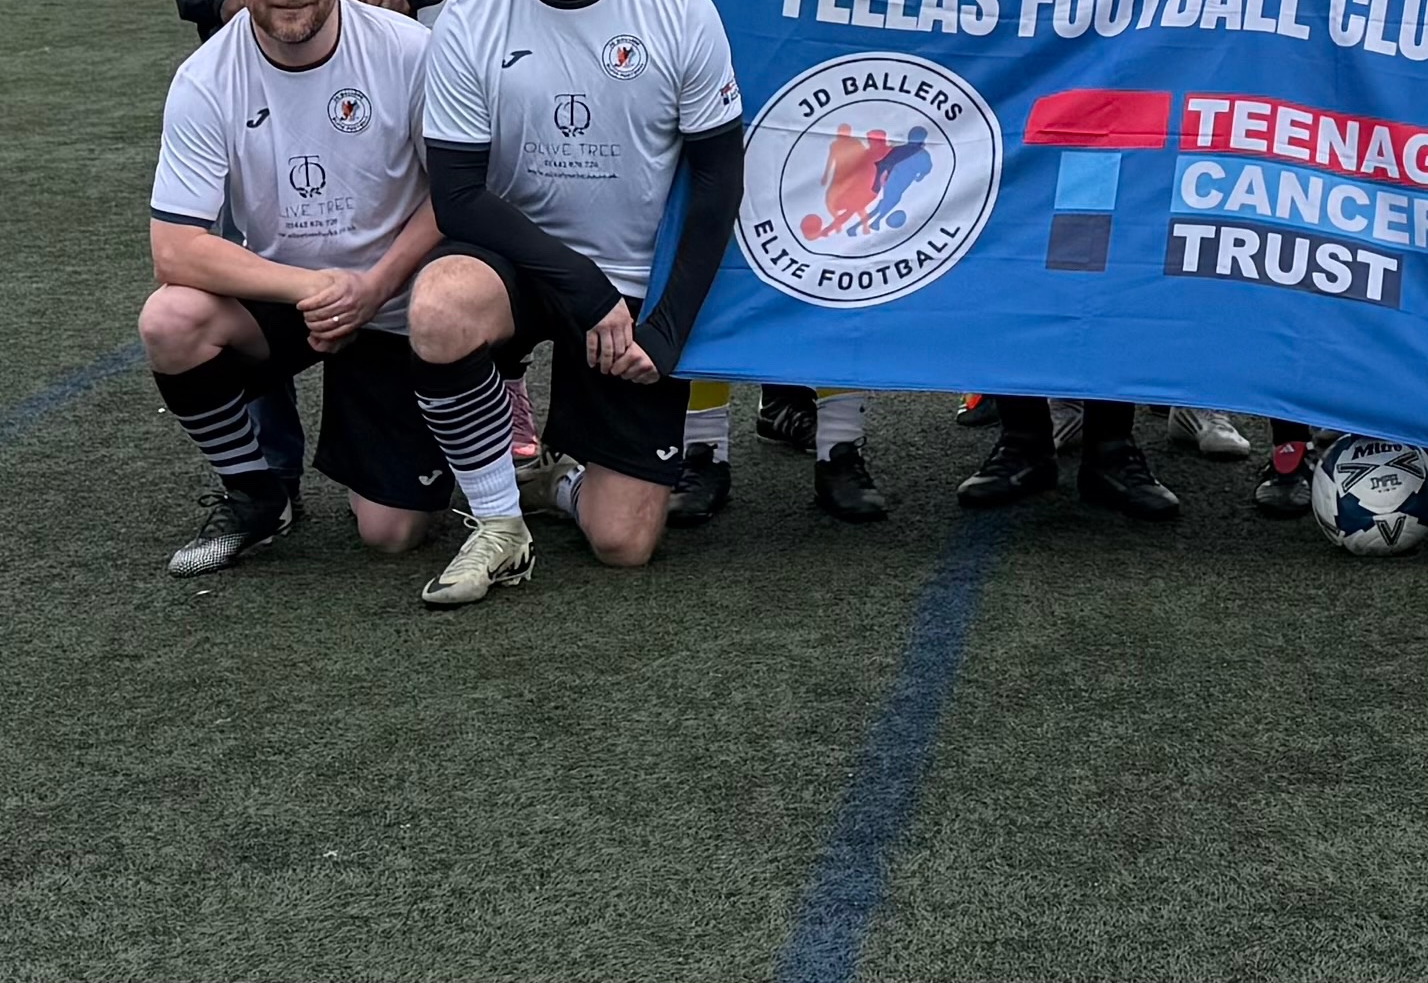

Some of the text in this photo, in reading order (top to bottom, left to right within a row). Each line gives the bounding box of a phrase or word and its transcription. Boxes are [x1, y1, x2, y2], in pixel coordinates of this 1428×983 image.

[798, 72, 963, 122] JD BALLERS
[523, 142, 621, 157] OLIVE TREE
[318, 196, 355, 215] TREE
[753, 219, 961, 290] ELITE FOOTBALL
[1172, 223, 1398, 301] TRUST
